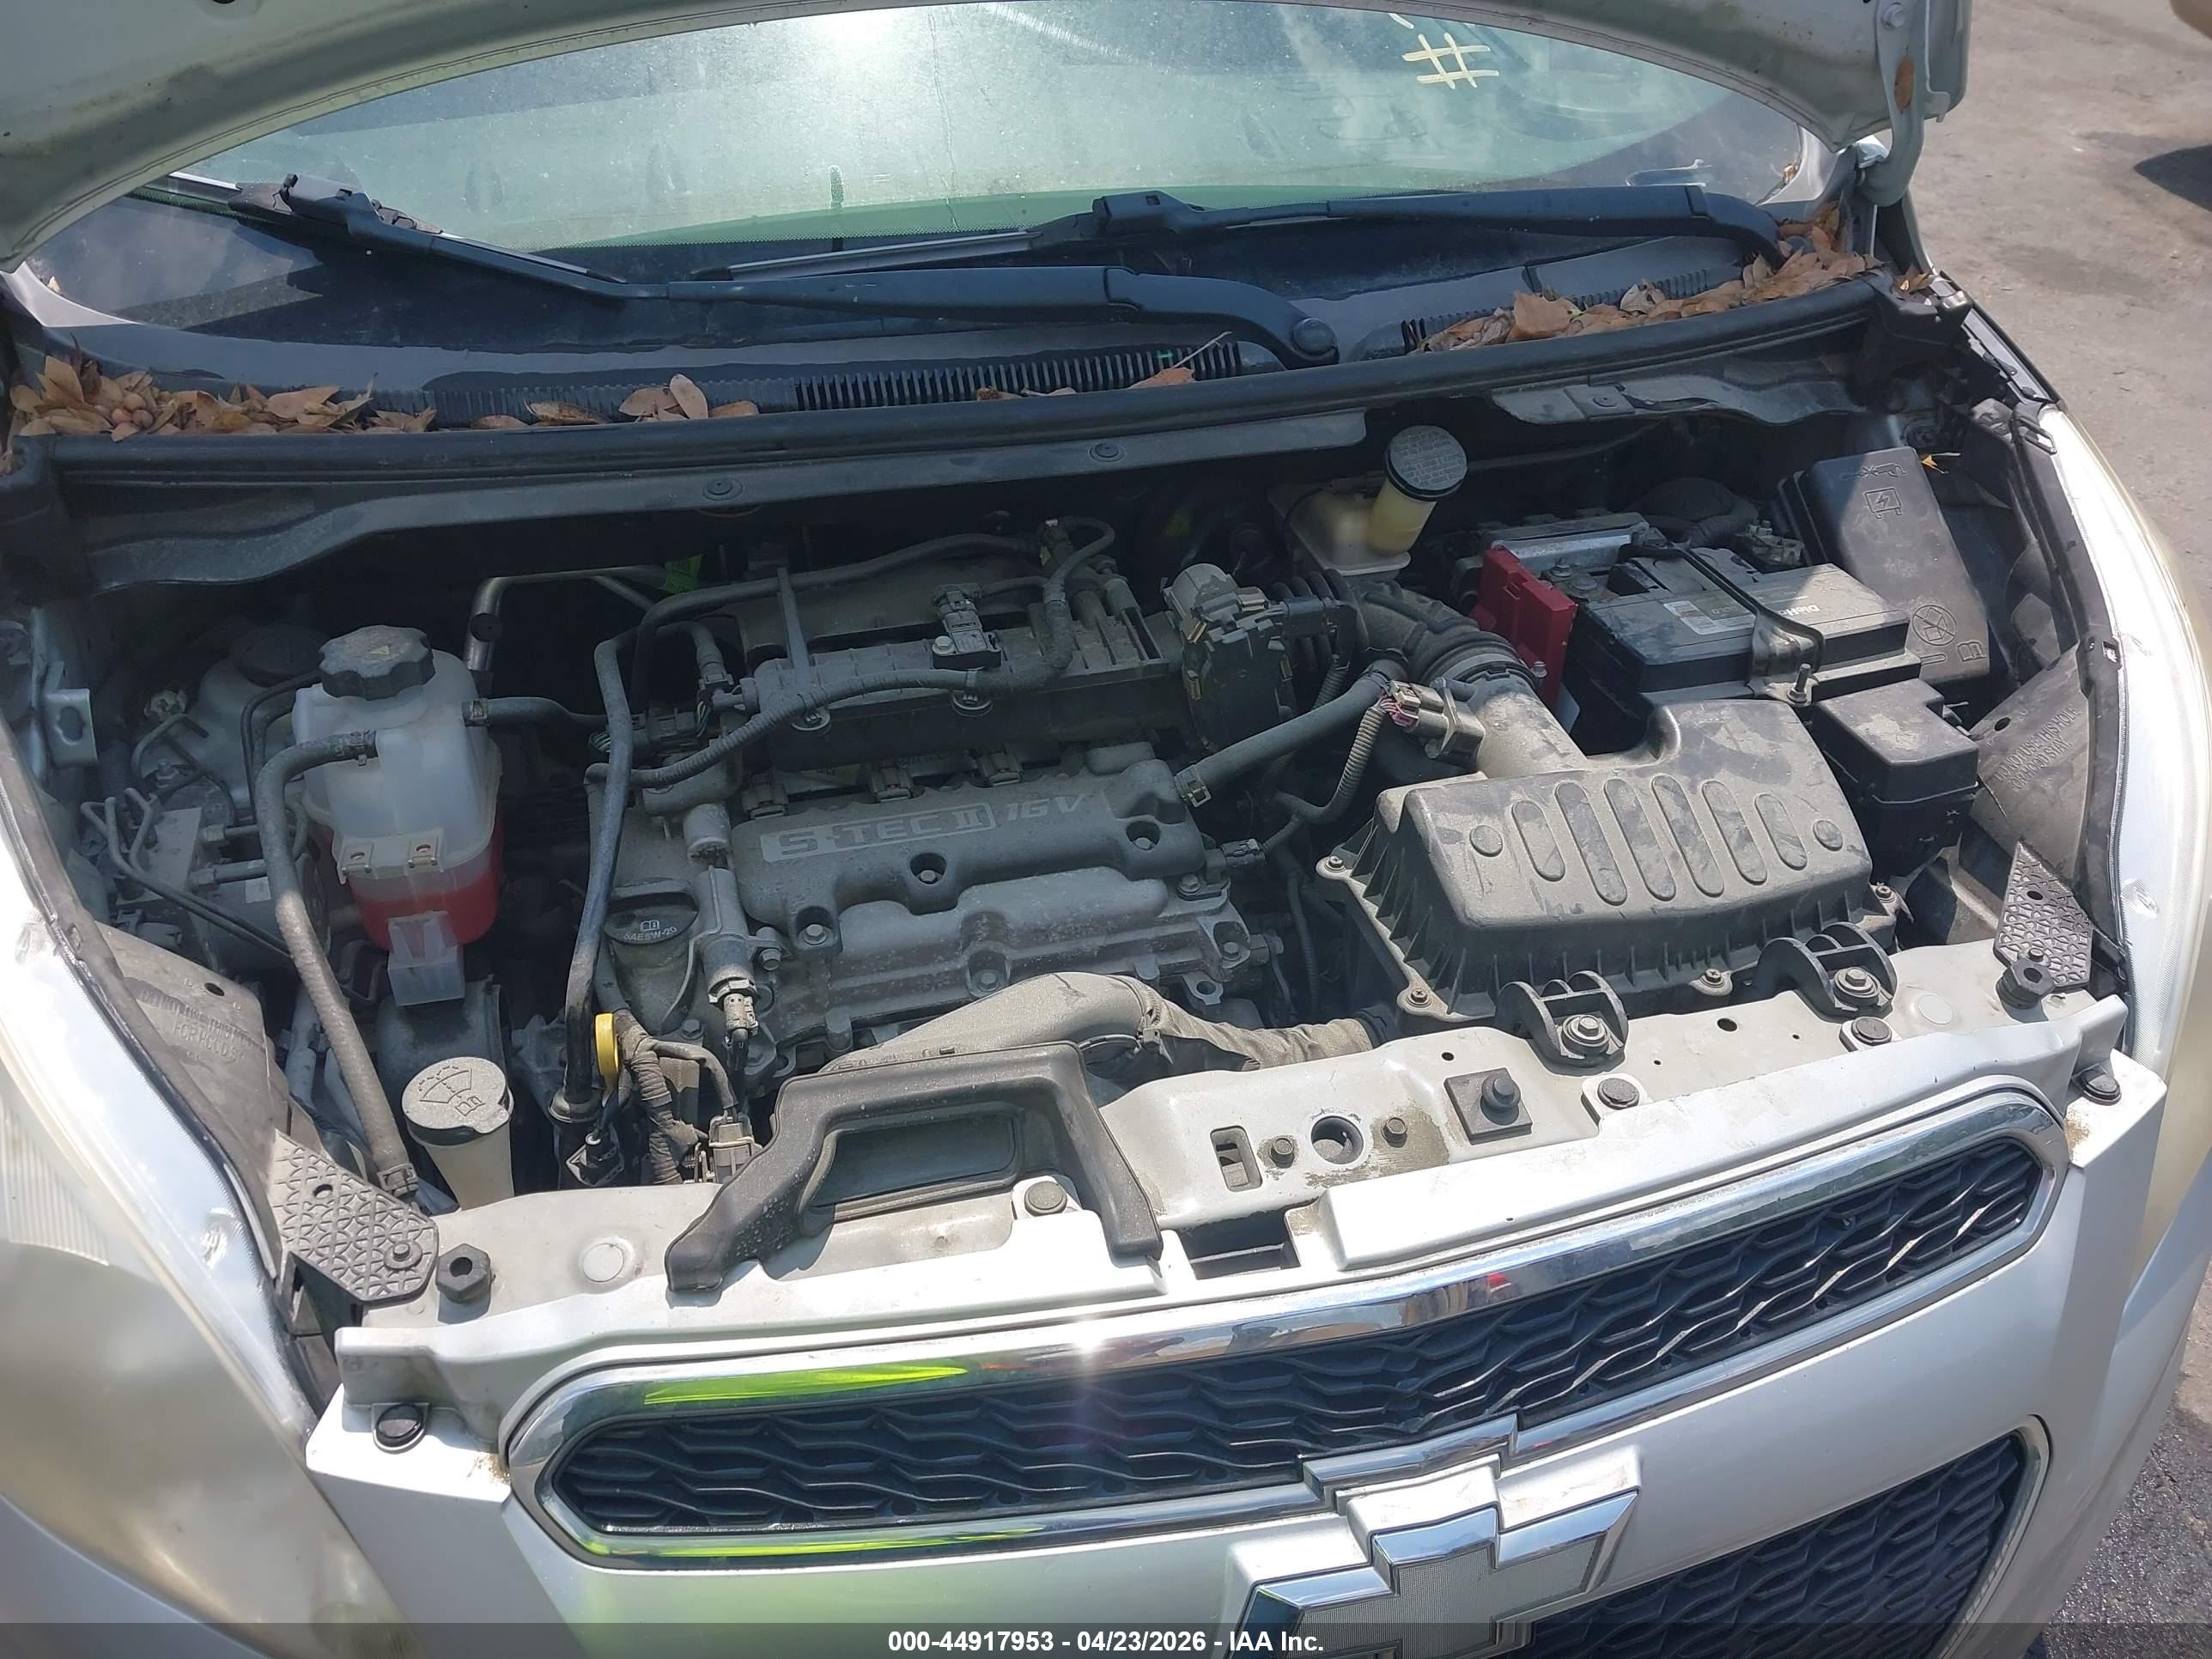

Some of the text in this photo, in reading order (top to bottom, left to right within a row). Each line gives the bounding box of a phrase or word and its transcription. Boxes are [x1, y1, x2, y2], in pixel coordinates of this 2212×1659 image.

[1778, 605, 1820, 616] DieHa
[2006, 748, 2027, 771] NOT
[2019, 736, 2043, 757] USE
[2036, 720, 2062, 742] THIS
[2021, 753, 2049, 779] HOOD
